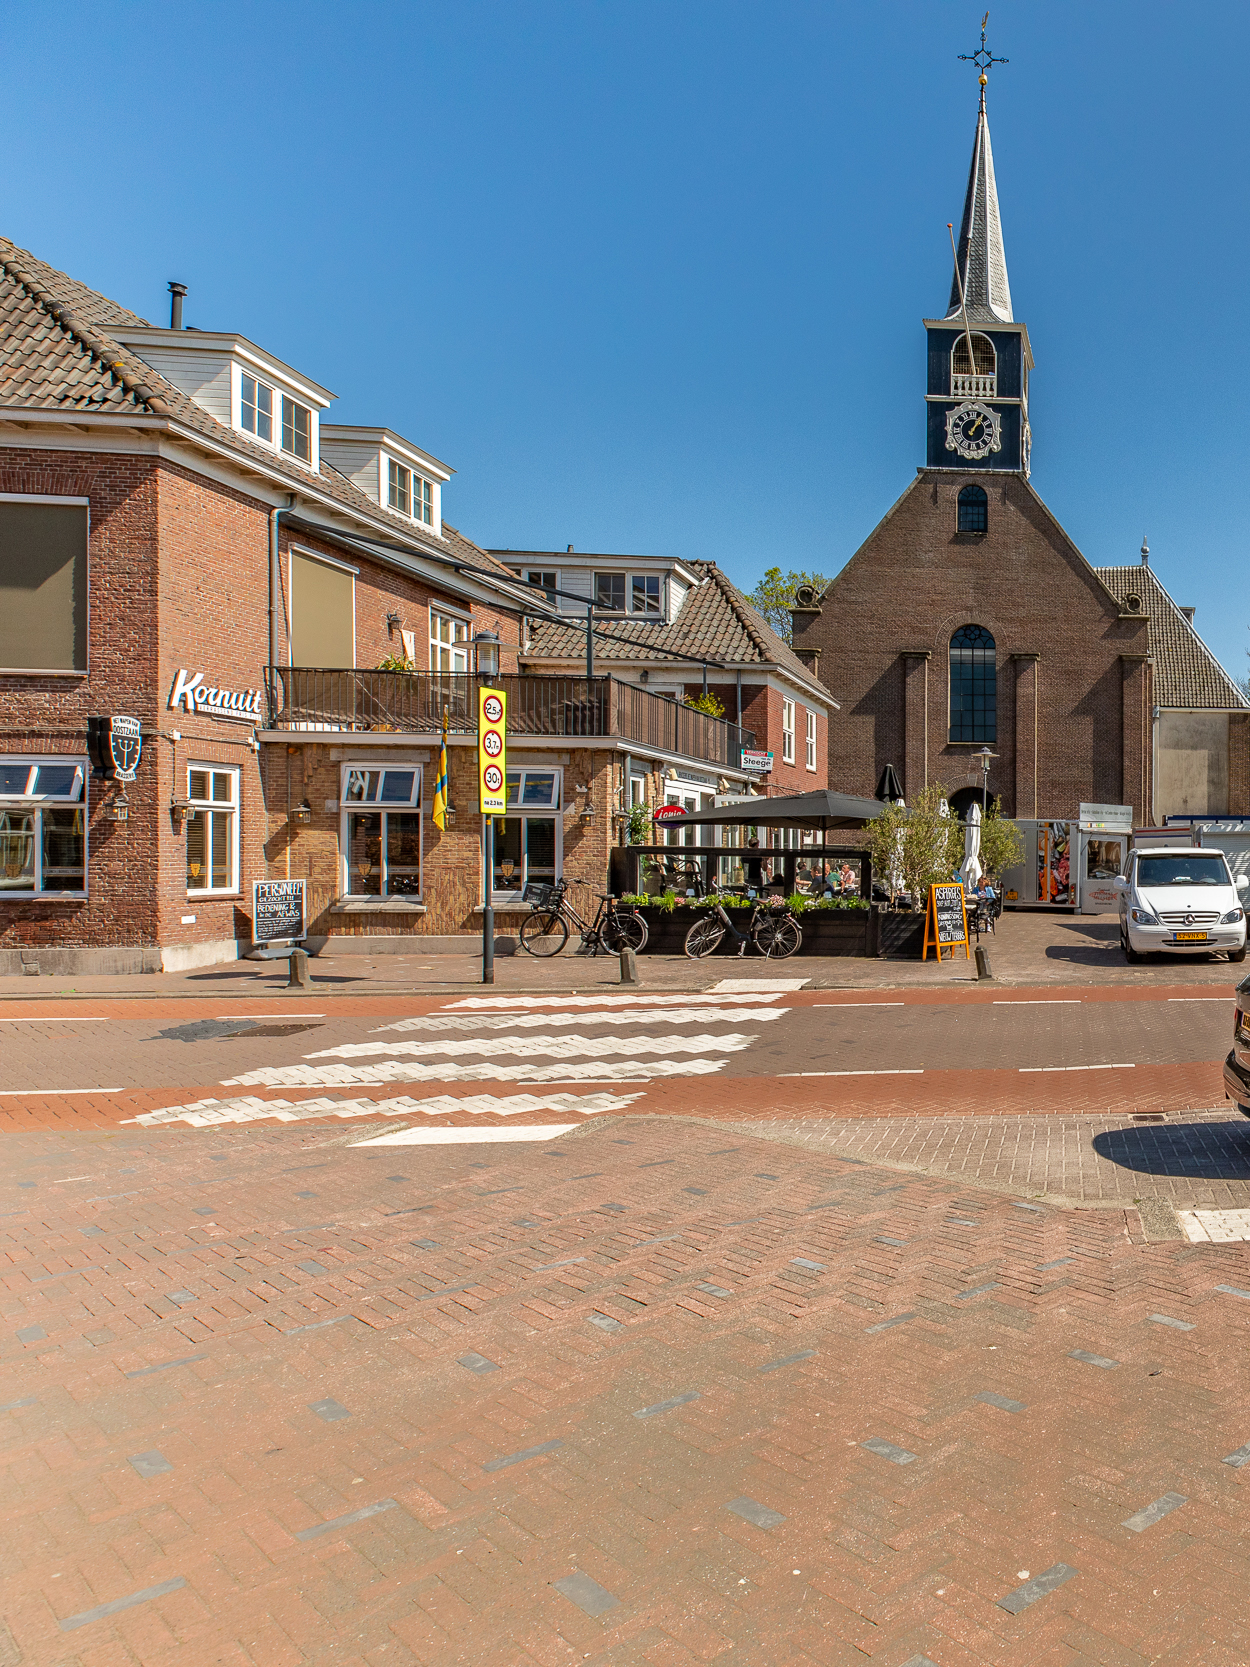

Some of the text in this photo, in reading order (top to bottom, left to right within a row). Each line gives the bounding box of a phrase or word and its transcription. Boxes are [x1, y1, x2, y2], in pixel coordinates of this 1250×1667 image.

[170, 669, 262, 713] Kornuit
[113, 725, 139, 737] OOSTZAAN
[743, 757, 771, 768] Steege
